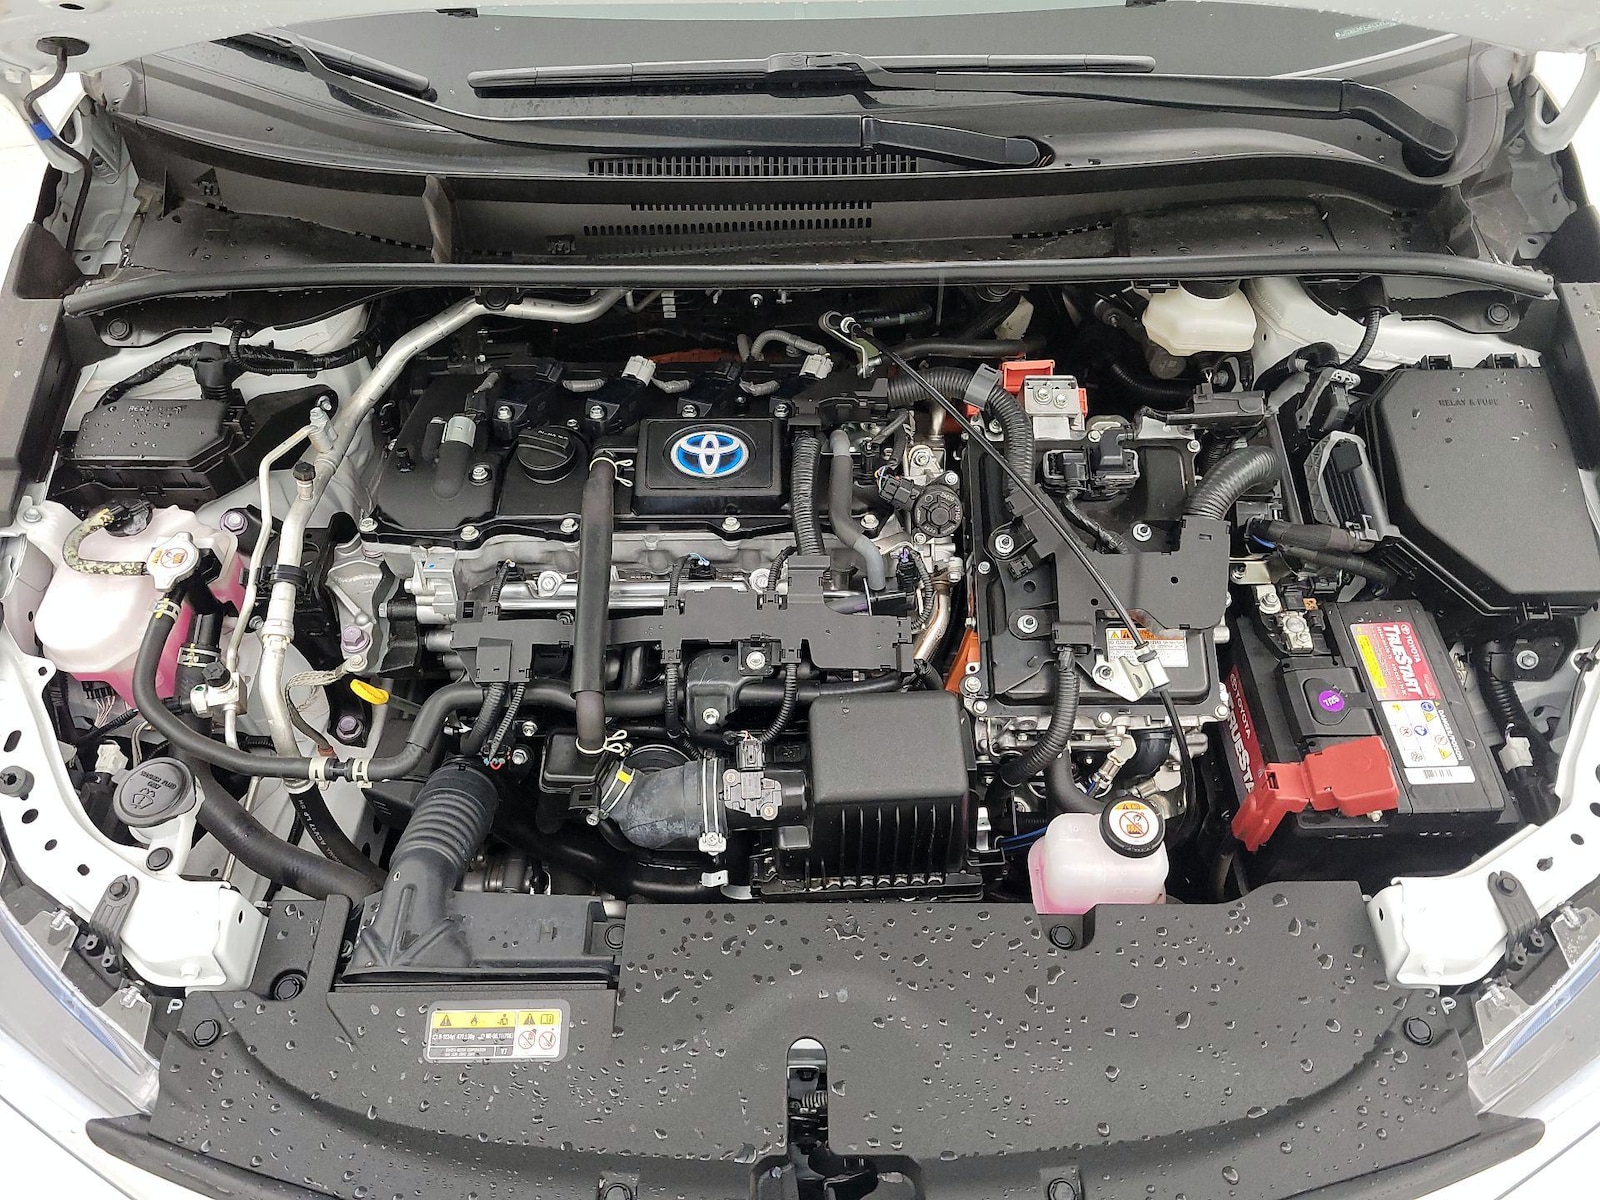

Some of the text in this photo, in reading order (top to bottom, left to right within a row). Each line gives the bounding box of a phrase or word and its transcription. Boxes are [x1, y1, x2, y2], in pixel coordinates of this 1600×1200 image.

[1438, 398, 1466, 406] RELAY
[1405, 634, 1422, 663] TOYOTA
[1235, 692, 1251, 740] TOYOTA
[1227, 691, 1255, 794] TRUESTA
